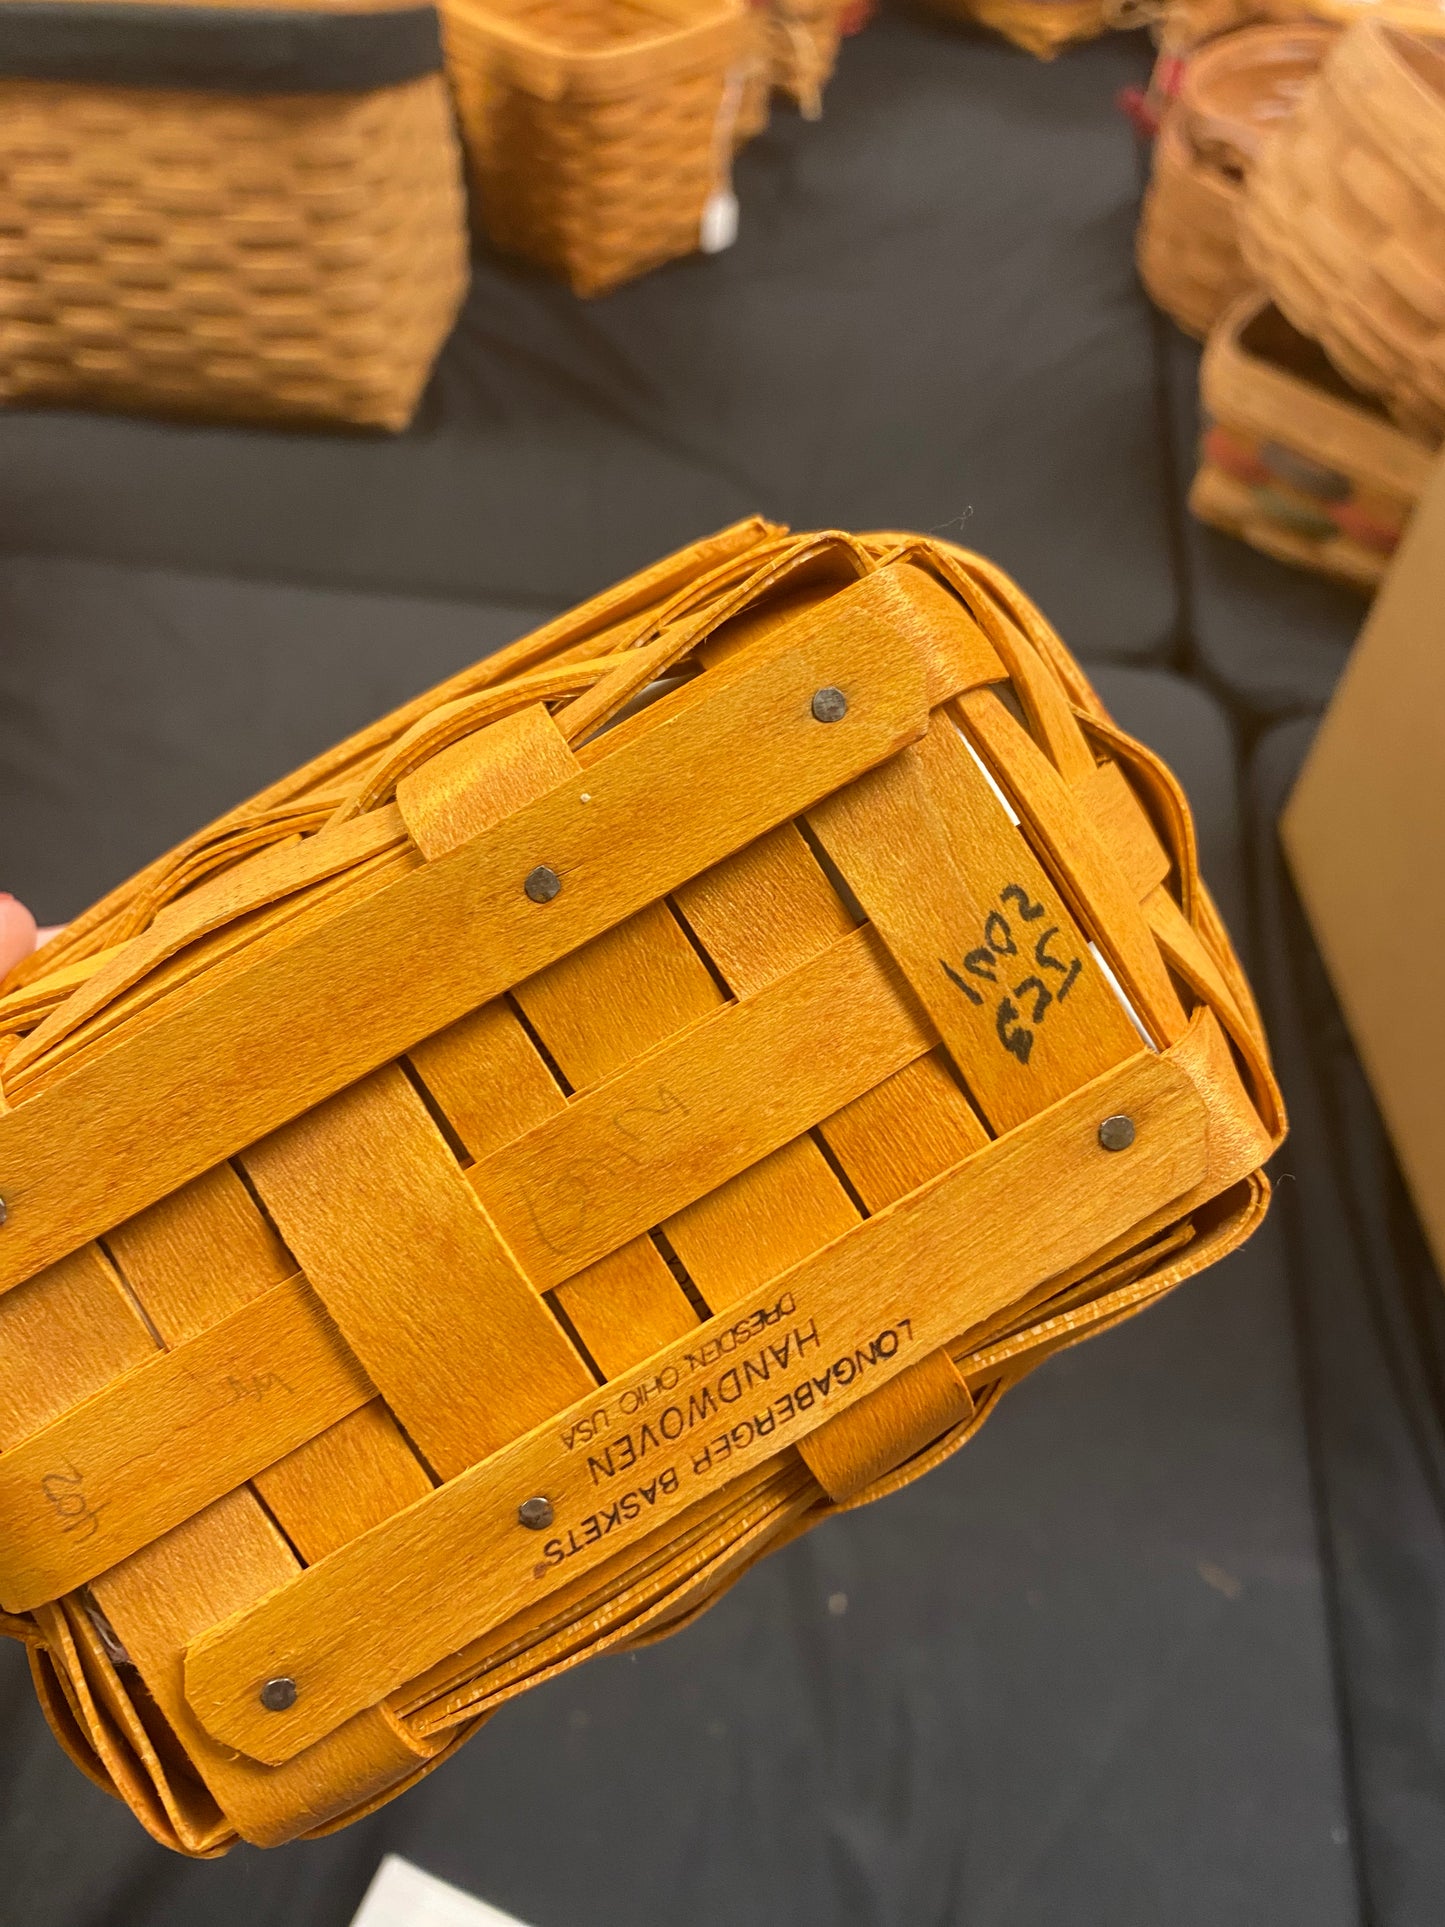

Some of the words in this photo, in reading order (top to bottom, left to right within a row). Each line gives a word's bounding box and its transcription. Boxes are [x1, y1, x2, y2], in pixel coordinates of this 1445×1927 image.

[560, 1409, 610, 1451] USA
[586, 1317, 821, 1487] HANDWOVEN
[618, 1366, 679, 1415] OHIO
[692, 1318, 914, 1475] LONGABERGER
[543, 1466, 680, 1565] BASKETS
